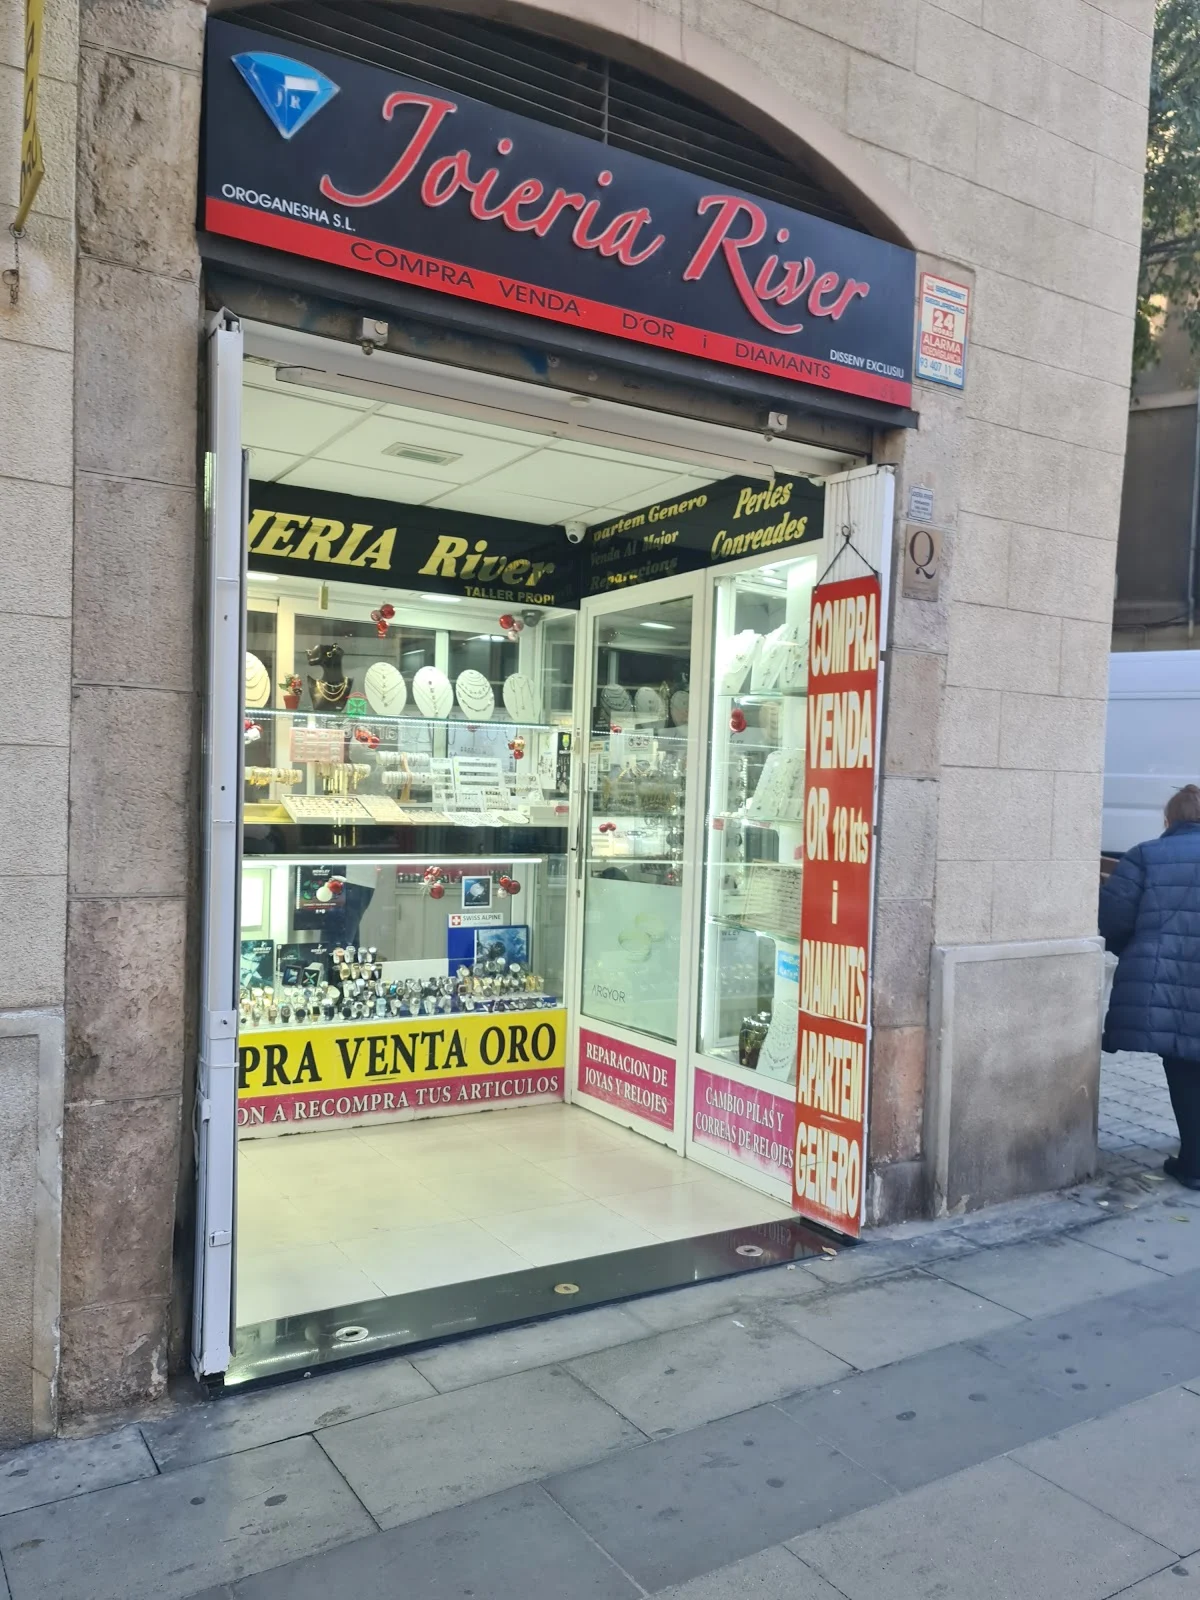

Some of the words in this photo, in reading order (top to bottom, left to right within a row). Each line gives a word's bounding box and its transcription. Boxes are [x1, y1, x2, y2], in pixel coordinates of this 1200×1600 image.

[222, 184, 329, 224] OROGANESHA
[332, 213, 356, 232] S.L.
[319, 90, 665, 266] Joieria
[683, 195, 870, 334] River
[350, 242, 475, 289] COMPRA
[498, 279, 580, 316] VENDA
[736, 343, 831, 380] DIAMANTS
[933, 310, 954, 331] 24
[829, 348, 865, 368] DISSENY
[866, 357, 905, 379] EXCLUSIU
[923, 334, 961, 354] ALARMA
[648, 495, 707, 522] Genero
[733, 482, 794, 519] Perles
[248, 509, 397, 570] IERIA
[418, 535, 554, 587] River
[642, 530, 679, 552] Major
[711, 512, 808, 560] Conreades
[909, 530, 937, 580] Q
[464, 585, 513, 601] TALLER
[811, 593, 876, 677] COMPRA
[809, 689, 873, 769] VENDA
[806, 786, 830, 861] OR
[832, 806, 848, 862] 18
[849, 806, 869, 864] kts
[831, 880, 838, 925] i
[592, 984, 626, 1003] ARGYOR
[799, 938, 866, 1024] DIAMANTS
[238, 1041, 322, 1089] PRA
[335, 1029, 468, 1080] VENTA
[480, 1023, 557, 1066] ORO
[586, 1042, 650, 1081] REPARACION
[653, 1064, 668, 1087] DE
[798, 1029, 864, 1123] APARTEM
[272, 1104, 287, 1122] A
[294, 1091, 408, 1121] RECOMPRA
[415, 1085, 451, 1106] TUS
[458, 1075, 559, 1102] ARTICULOS
[585, 1067, 613, 1092] JOYAS
[615, 1079, 622, 1096] Y
[624, 1082, 667, 1114] RELOJES
[705, 1087, 744, 1116] CAMBIO
[746, 1101, 774, 1129] PILAS
[776, 1112, 784, 1132] Y
[695, 1112, 736, 1143] CORREAS
[738, 1128, 751, 1150] DE
[753, 1134, 794, 1169] RELOJES
[795, 1121, 860, 1219] GENERO
